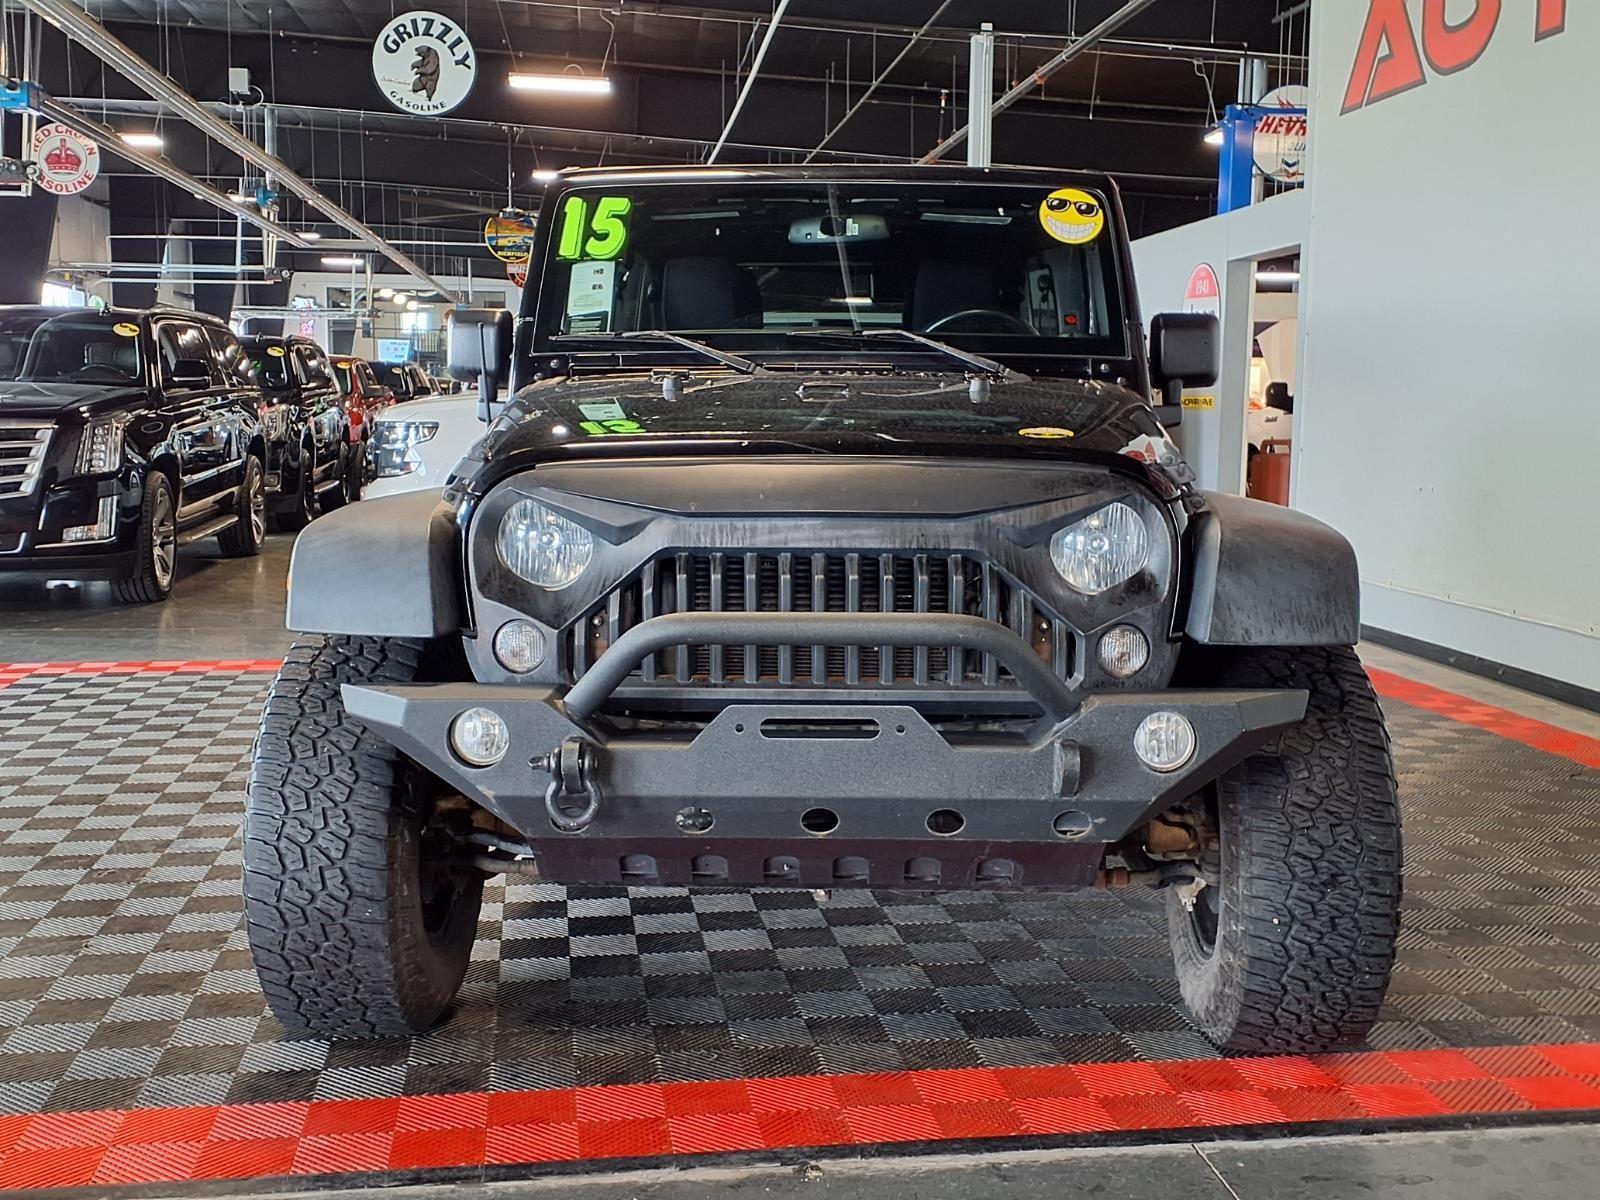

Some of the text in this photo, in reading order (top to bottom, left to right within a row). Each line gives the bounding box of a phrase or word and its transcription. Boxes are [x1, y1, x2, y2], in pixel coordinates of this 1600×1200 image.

[383, 18, 471, 70] GRIZZLY
[1339, 0, 1567, 116] AU
[390, 90, 446, 111] GASOLINE
[1254, 115, 1307, 137] HEVR
[38, 169, 95, 193] ASOLINE
[558, 196, 631, 259] 15
[1195, 280, 1210, 295] 1941
